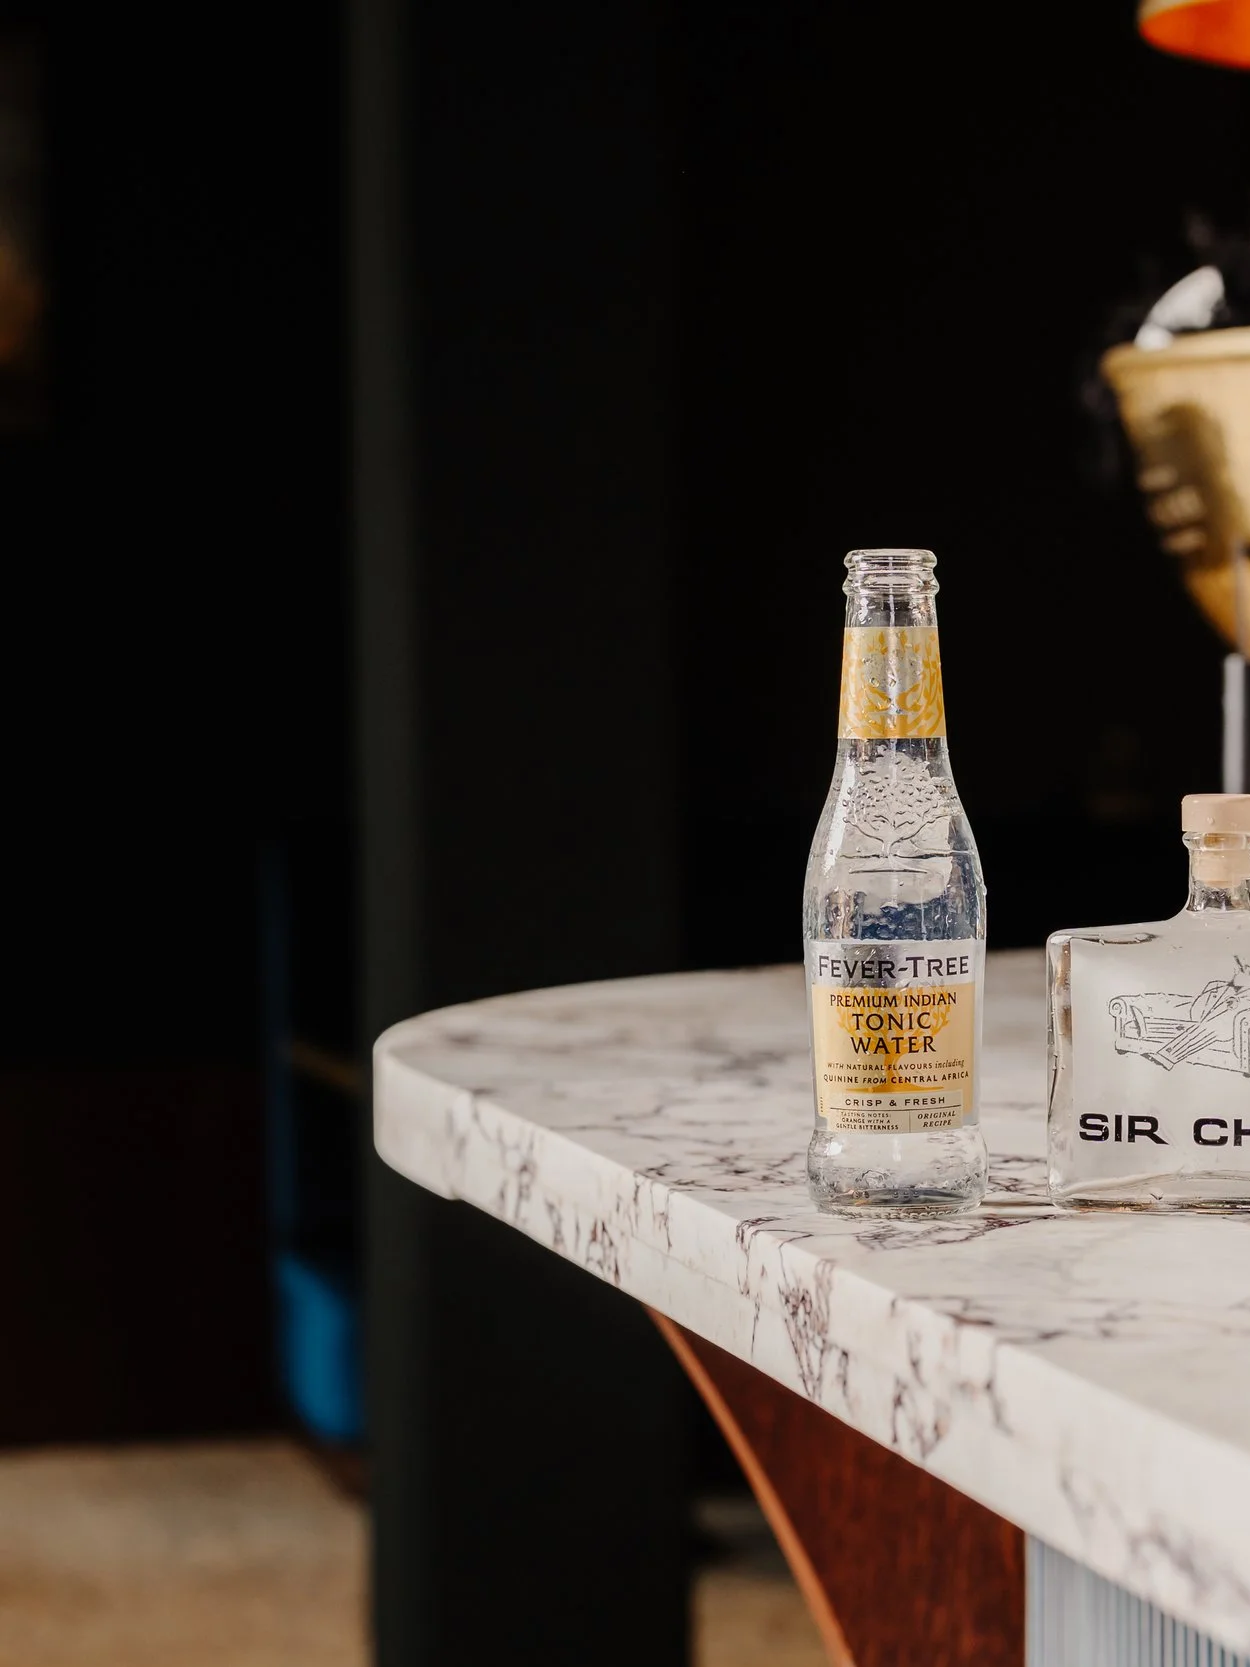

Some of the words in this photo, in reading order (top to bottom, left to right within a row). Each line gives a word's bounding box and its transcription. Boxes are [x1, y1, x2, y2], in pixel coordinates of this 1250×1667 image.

[819, 955, 969, 979] FEVER-TREE
[830, 994, 898, 1008] PREMIUM
[905, 992, 957, 1006] INDIAN
[852, 1012, 931, 1031] TONIC
[851, 1036, 936, 1055] WATER
[827, 1063, 844, 1071] WITH
[846, 1063, 885, 1071] NATURAL
[888, 1063, 932, 1071] FLAVOURS
[935, 1059, 964, 1069] including
[824, 1075, 859, 1084] QUININE
[891, 1075, 938, 1084] CENTRAL
[941, 1070, 969, 1081] AFRICA
[845, 1098, 882, 1106] CRISP
[889, 1099, 897, 1107] &
[905, 1097, 945, 1105] FRESH
[917, 1110, 956, 1119] ORIGINAL
[922, 1119, 952, 1128] RECIPE
[1079, 1113, 1169, 1145] SIR
